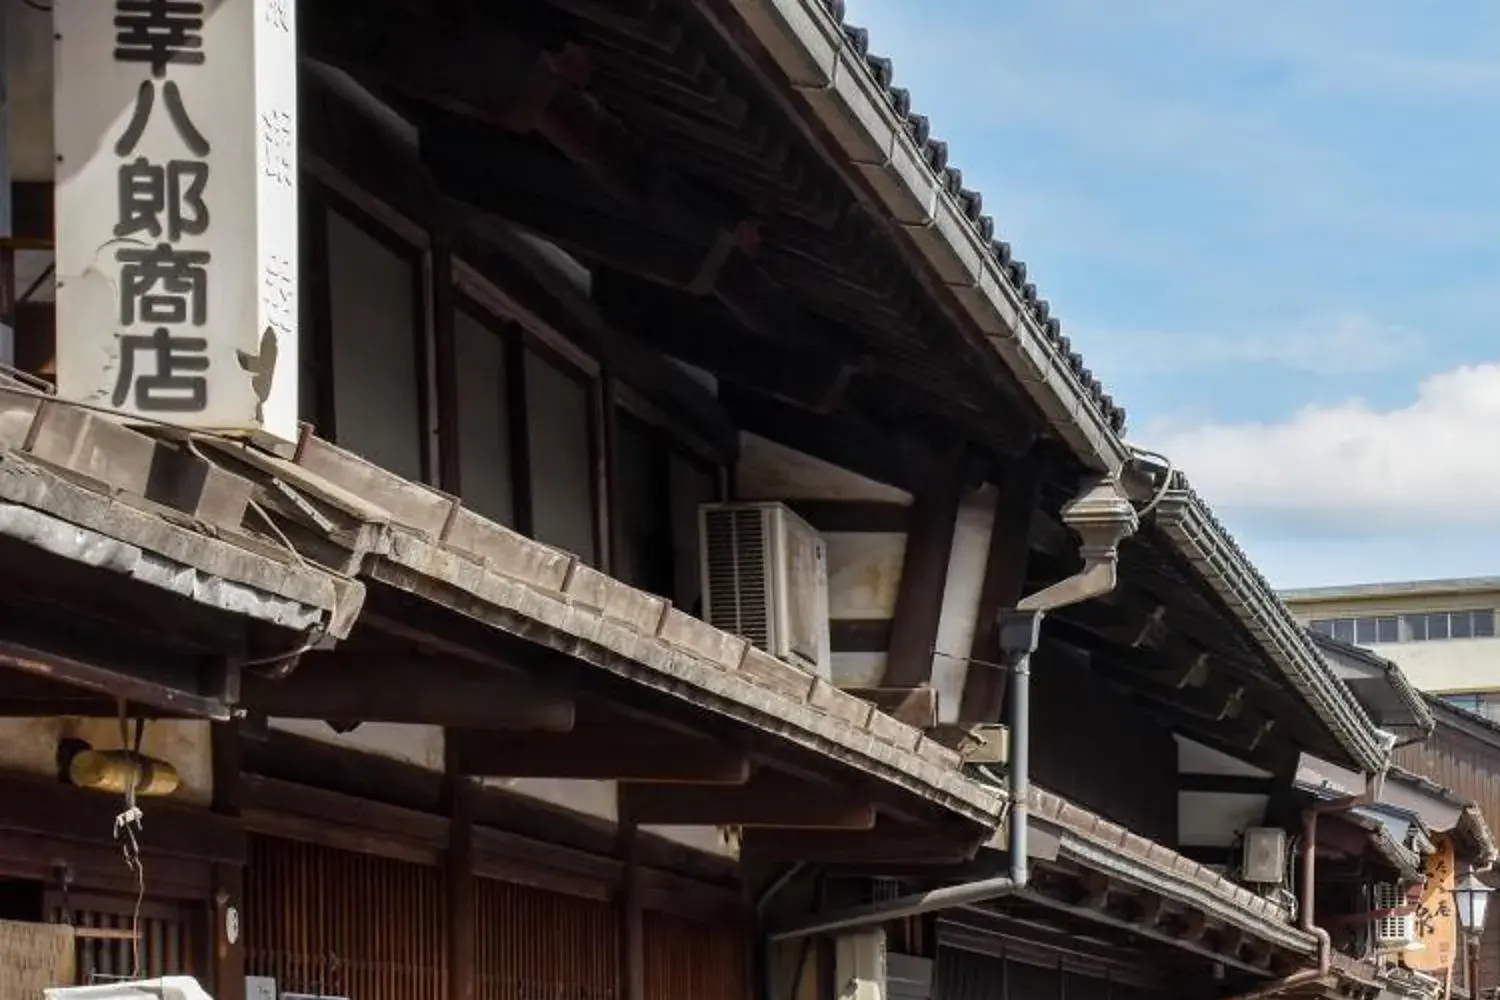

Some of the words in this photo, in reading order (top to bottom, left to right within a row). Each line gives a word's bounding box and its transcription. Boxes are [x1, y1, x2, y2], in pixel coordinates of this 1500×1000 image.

[112, 0, 211, 412] 幸八郎商店
